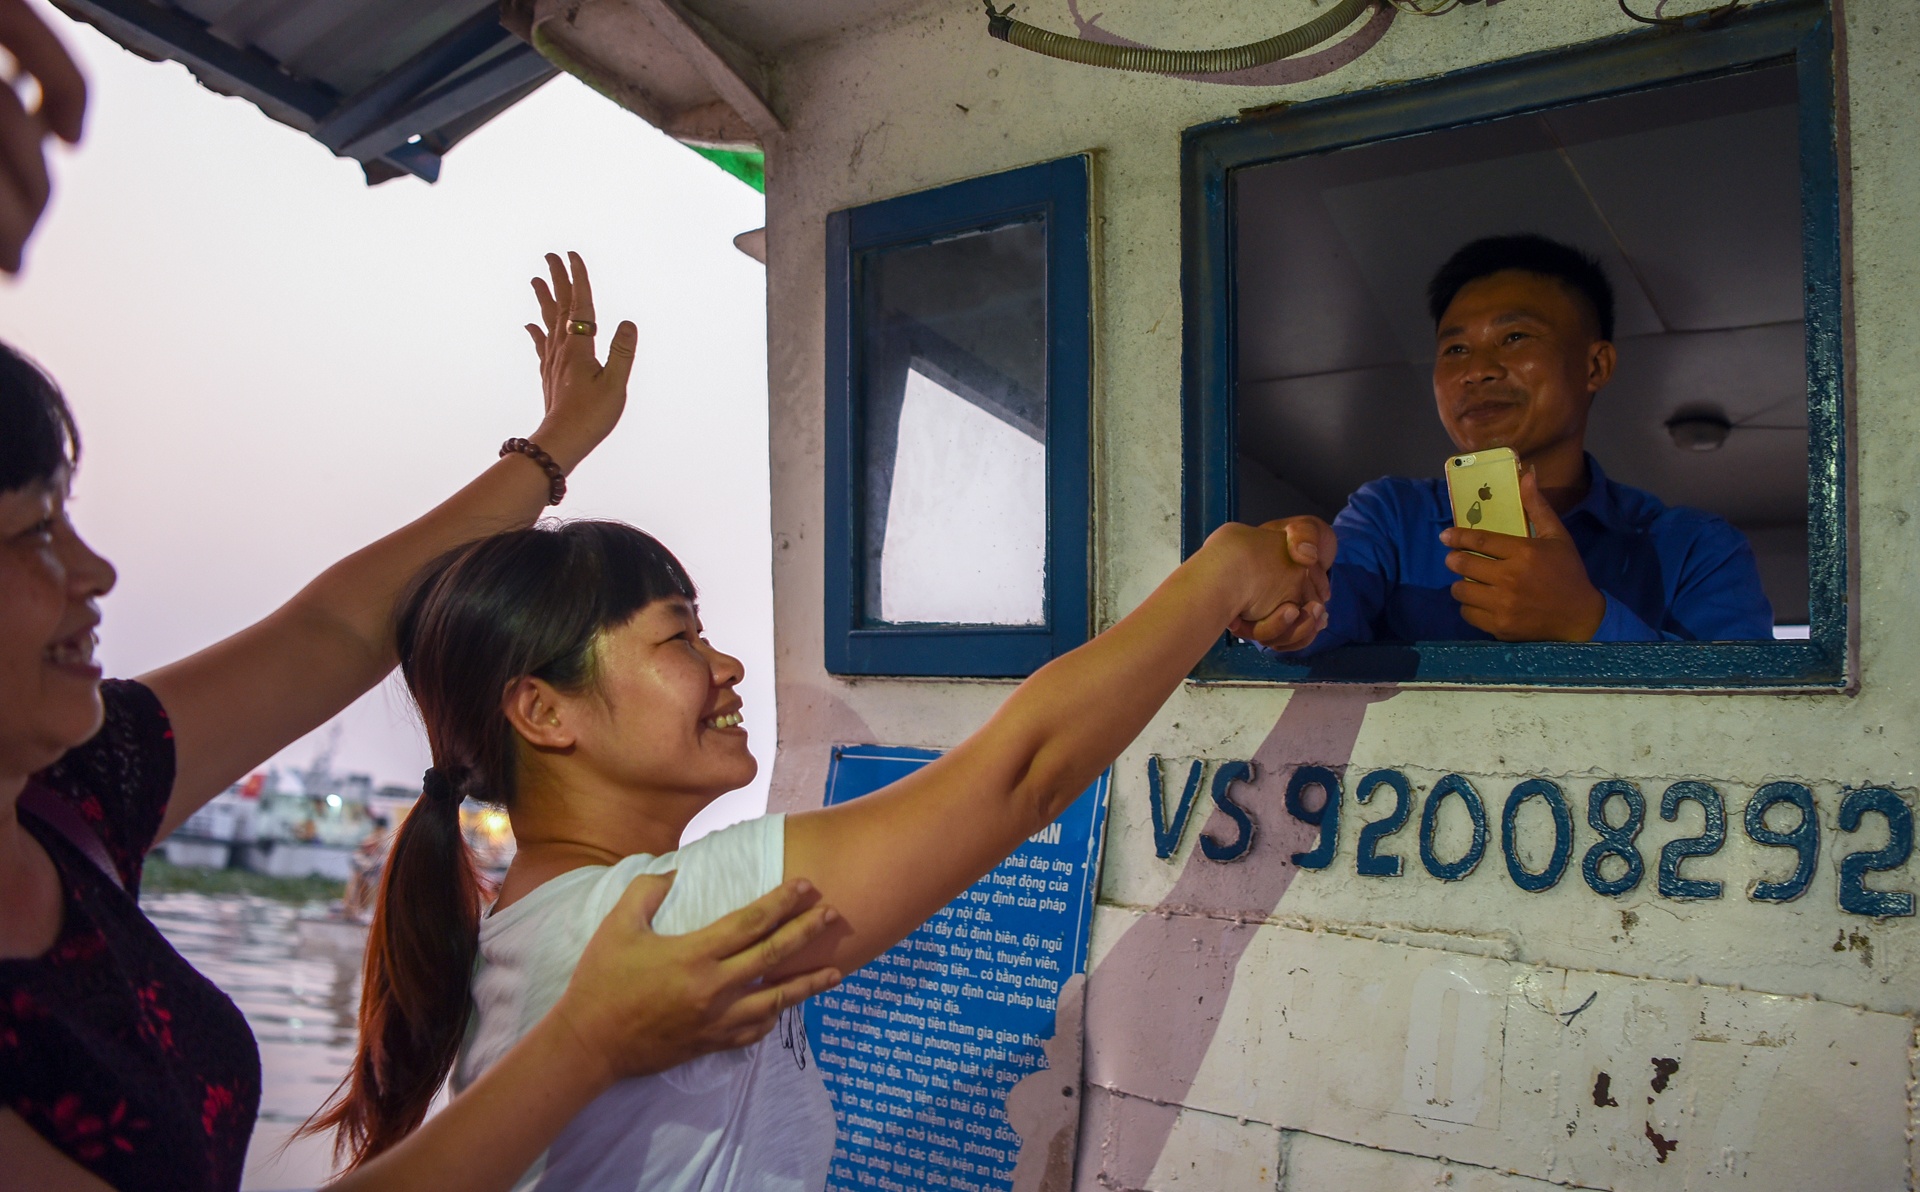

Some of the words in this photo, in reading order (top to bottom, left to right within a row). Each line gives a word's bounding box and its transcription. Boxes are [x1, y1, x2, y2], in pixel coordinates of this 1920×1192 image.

[1148, 756, 1254, 864] VS
[1284, 765, 1916, 918] 92008292
[1004, 854, 1028, 869] phải
[1030, 856, 1050, 872] đáp
[1052, 858, 1073, 875] ứng
[993, 872, 1016, 889] hoạt
[1018, 874, 1046, 892] động
[1048, 876, 1069, 892] của
[956, 906, 973, 922] nội
[975, 908, 993, 924] địa.
[971, 891, 990, 905] quy
[992, 890, 1015, 907] định
[1018, 892, 1036, 908] của
[1039, 897, 1067, 914] pháp
[955, 922, 968, 938] đủ
[970, 926, 992, 943] định
[995, 930, 1020, 947] biên,
[1022, 933, 1040, 950] đội
[893, 954, 911, 967] trên
[913, 957, 948, 976] phương
[980, 968, 994, 980] có
[1024, 974, 1058, 994] chứng
[975, 945, 994, 963] thủ,
[1035, 956, 1060, 972] viên,
[846, 982, 872, 1000] thông
[926, 998, 942, 1013] nội
[944, 1000, 962, 1016] địa.
[860, 967, 879, 980] môn
[880, 970, 898, 984] phù
[900, 973, 917, 990] hợp
[918, 977, 939, 991] theo
[941, 982, 959, 997] quy
[962, 983, 984, 1000] định
[986, 986, 1004, 1002] của
[1007, 992, 1034, 1009] pháp
[1036, 995, 1056, 1013] luật
[824, 996, 840, 1009] Khi
[890, 1010, 925, 1029] phương
[928, 1017, 946, 1032] tiện
[948, 1020, 974, 1036] tham
[977, 1026, 994, 1040] gia
[996, 1029, 1019, 1044] giao
[857, 1041, 873, 1053] các
[874, 1046, 891, 1060] quy
[892, 1047, 912, 1063] định
[914, 1050, 932, 1066] của
[934, 1057, 958, 1073] pháp
[960, 1061, 979, 1078] luật
[996, 1069, 1018, 1083] giao
[912, 1032, 923, 1045] lái
[924, 1036, 960, 1055] phương
[963, 1042, 982, 1058] tiện
[984, 1046, 1006, 1060] phải
[1008, 1050, 1035, 1068] tuyệt
[870, 1062, 885, 1077] nội
[856, 1077, 874, 1091] trên
[915, 1090, 933, 1106] tiện
[935, 1095, 948, 1107] có
[950, 1098, 970, 1112] thái
[972, 1102, 986, 1119] độ
[876, 1101, 887, 1112] có
[966, 1122, 992, 1140] cộng
[908, 1146, 926, 1161] các
[952, 1156, 974, 1174] kiện
[977, 1164, 990, 1176] an
[927, 1131, 960, 1151] khách,
[964, 1141, 1005, 1163] phương
